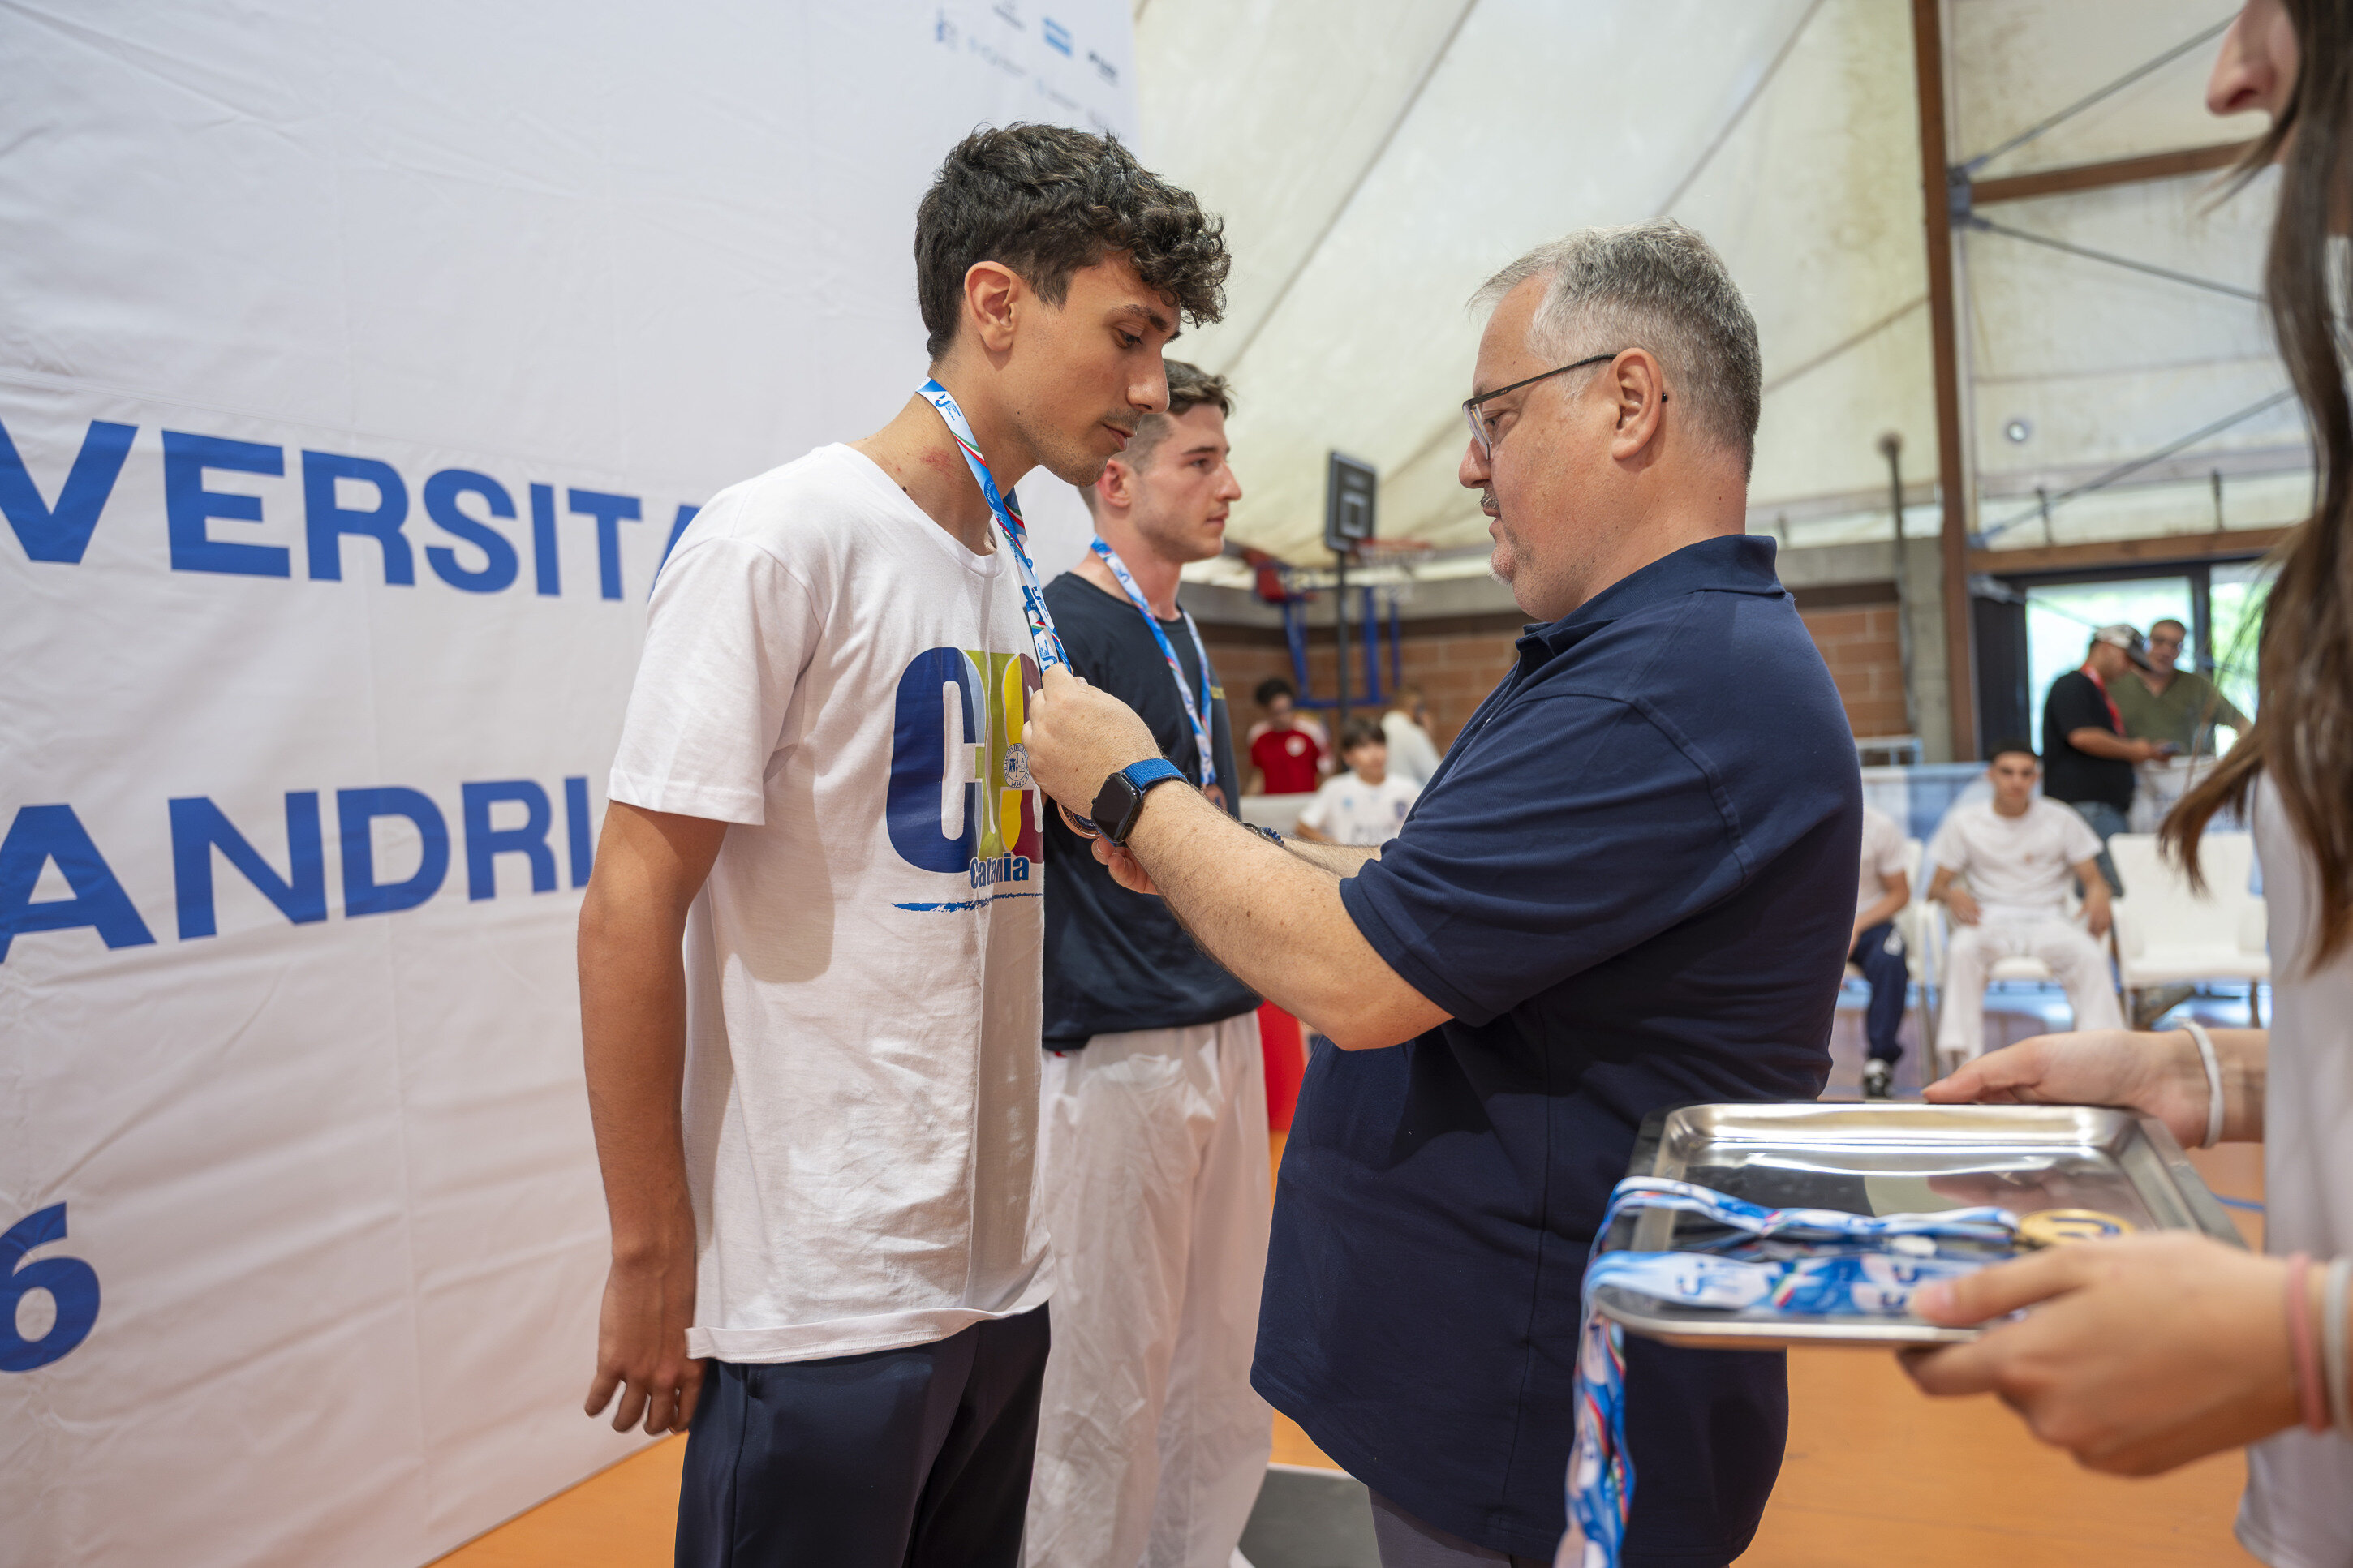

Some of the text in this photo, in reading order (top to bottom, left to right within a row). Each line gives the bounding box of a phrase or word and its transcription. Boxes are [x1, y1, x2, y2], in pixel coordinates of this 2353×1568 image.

[0, 776, 591, 964] ANDRI
[970, 853, 1030, 889] Catania
[0, 1200, 101, 1373] 6
